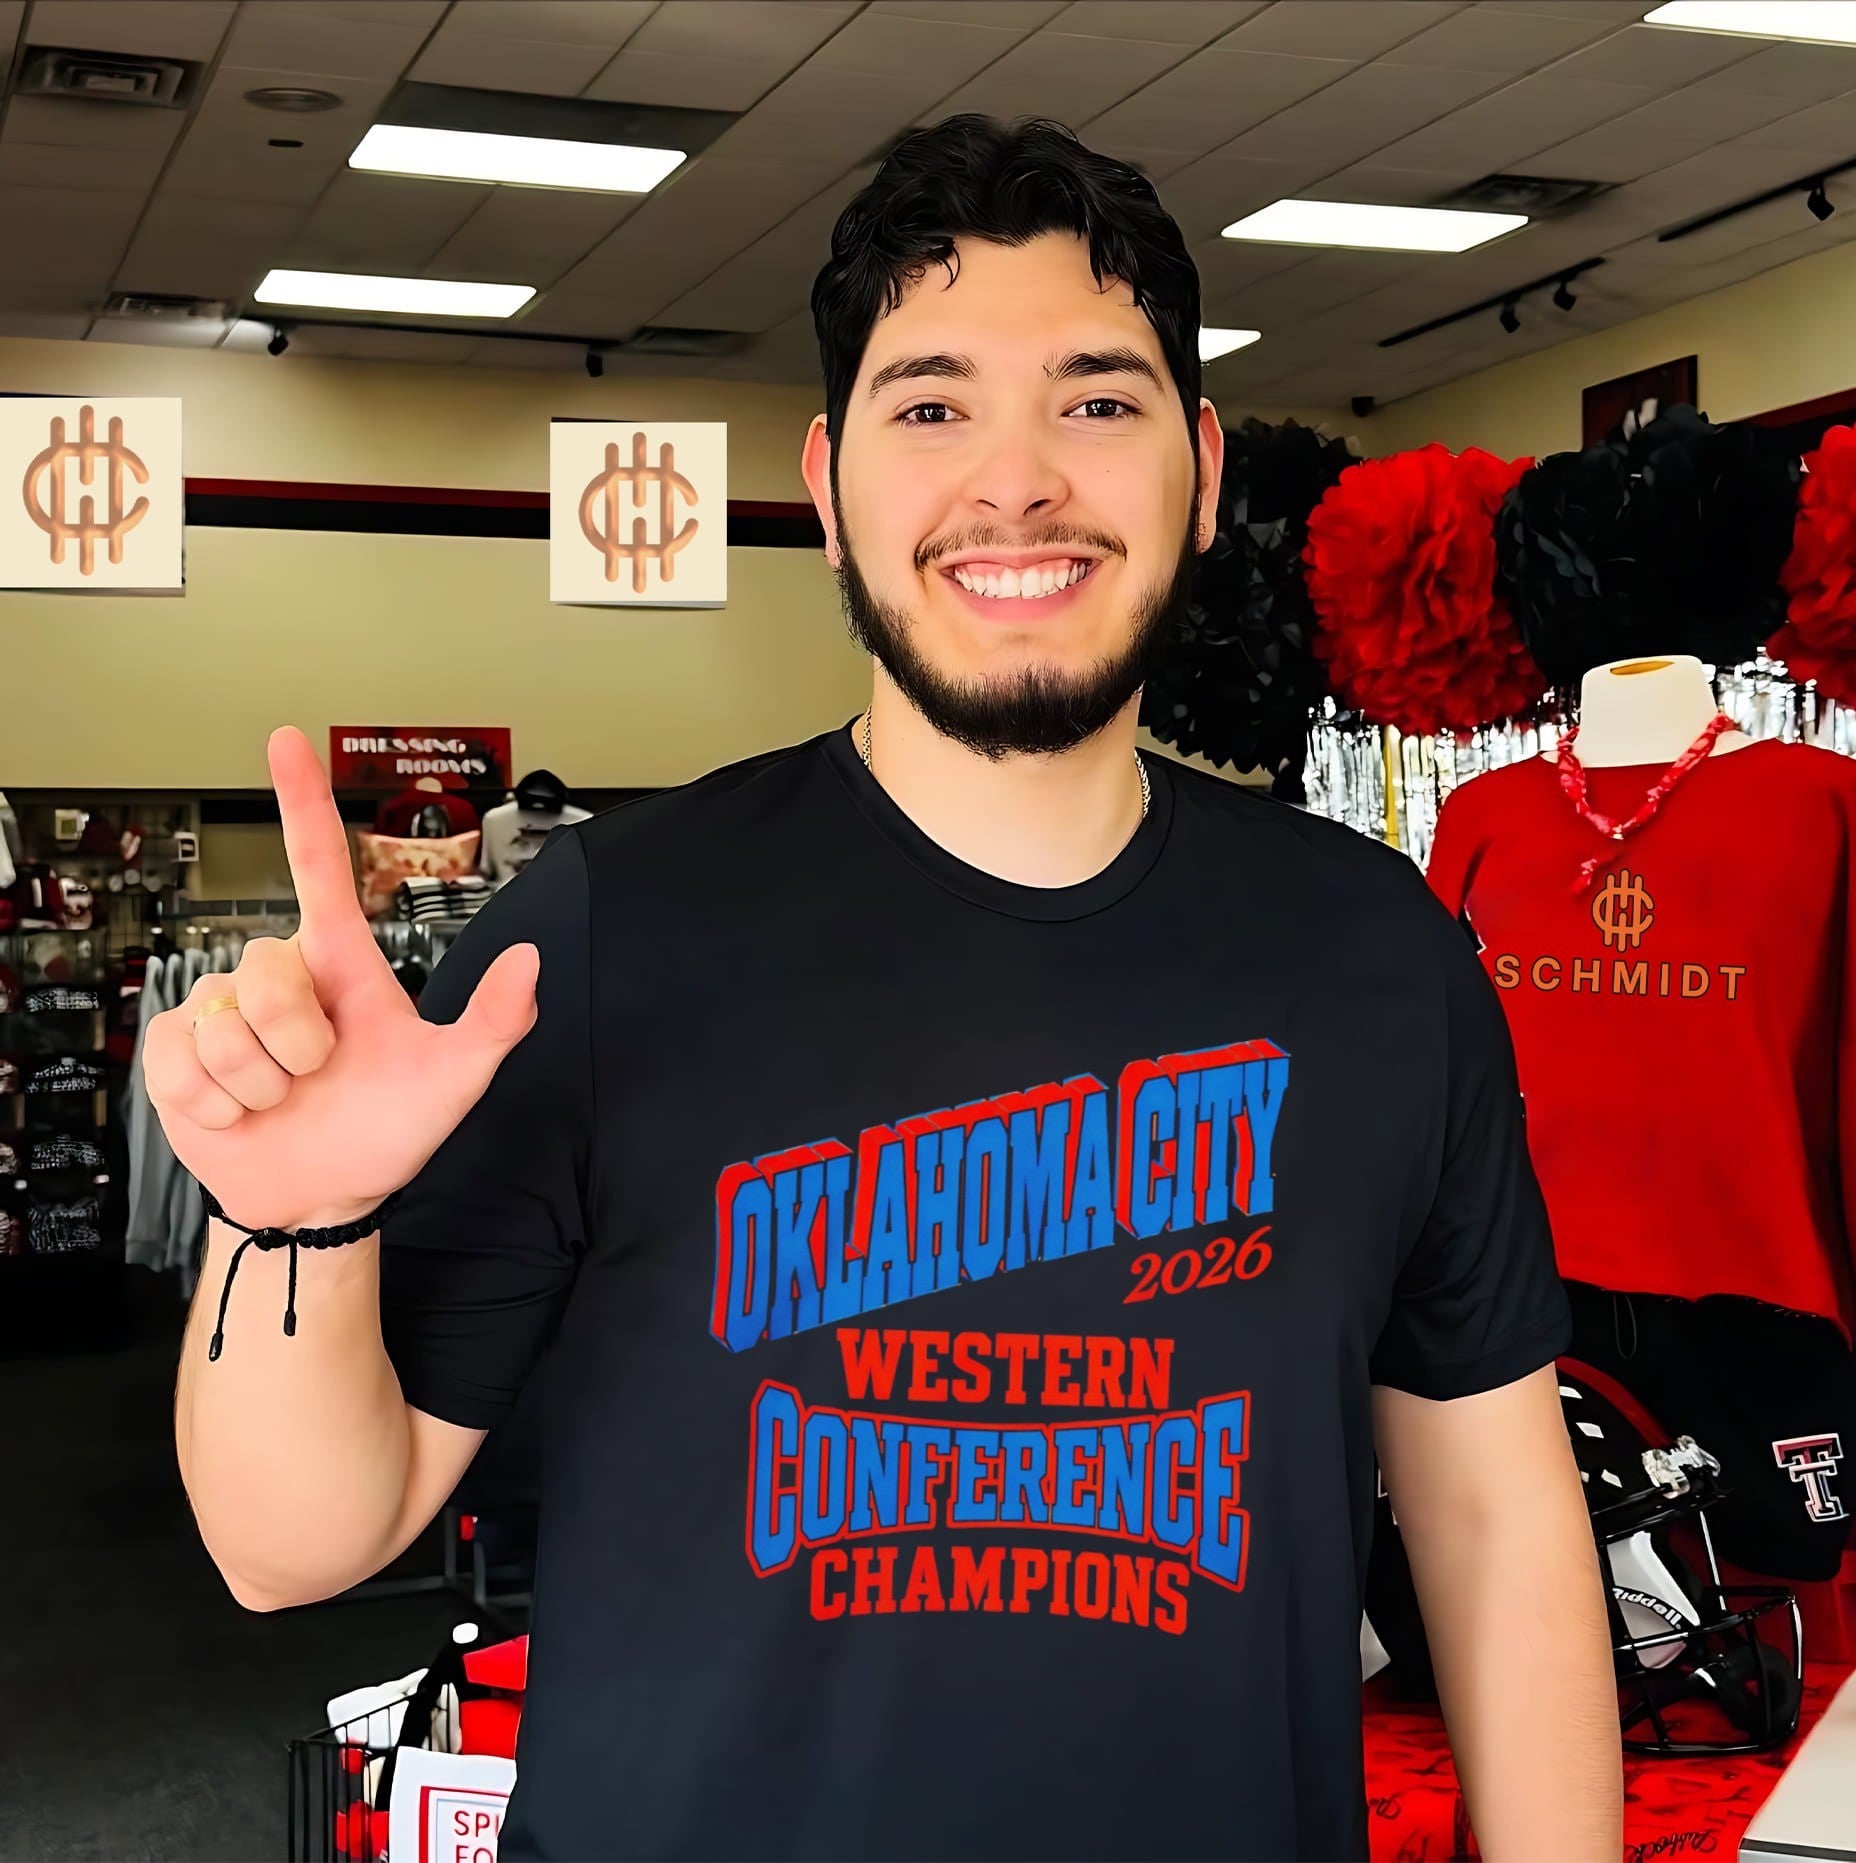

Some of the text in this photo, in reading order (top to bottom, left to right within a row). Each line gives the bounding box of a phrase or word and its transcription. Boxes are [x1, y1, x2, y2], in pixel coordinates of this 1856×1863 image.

[342, 737, 467, 754] DRESSING
[396, 758, 487, 775] ROOMS
[1494, 954, 1747, 1000] SCHMIDT
[709, 1038, 1291, 1353] OKLAHOMA CITY
[1123, 1226, 1273, 1304] 2026
[837, 1328, 1175, 1410] WESTERN
[745, 1378, 1251, 1593] CONFERENCE
[810, 1546, 1191, 1636] CHAMPIONS
